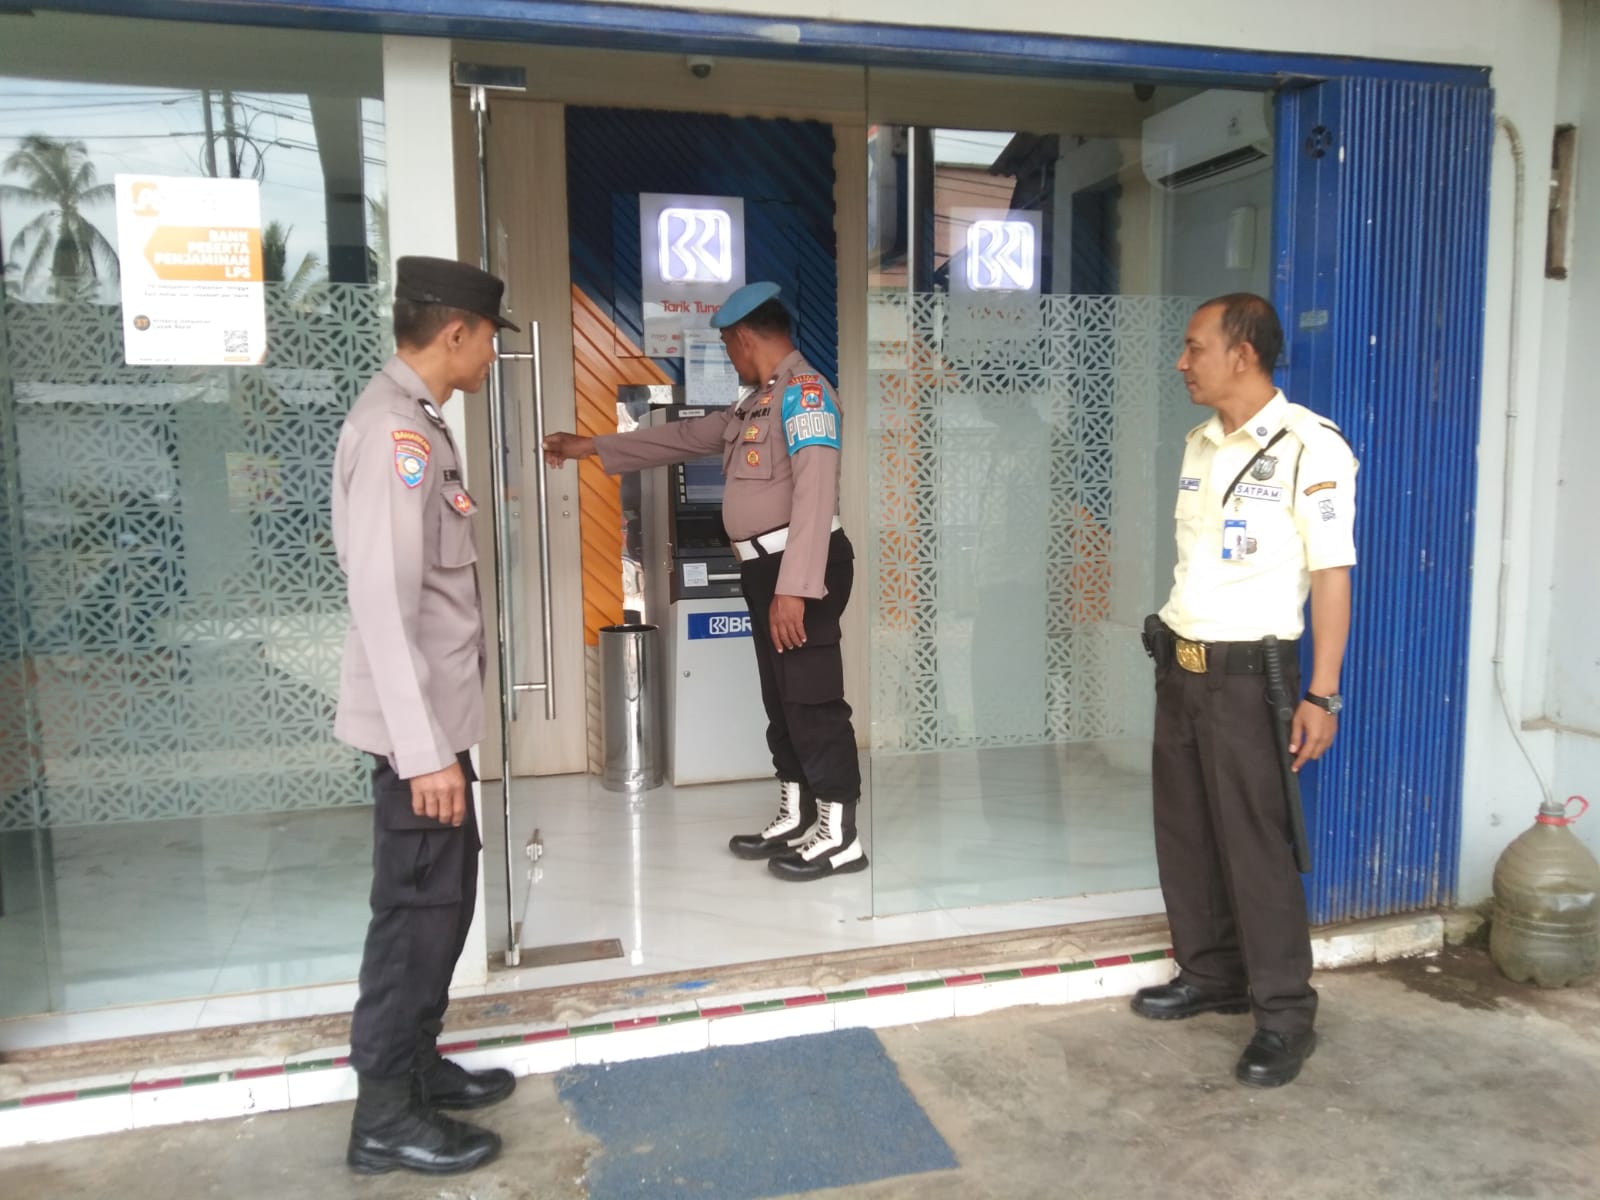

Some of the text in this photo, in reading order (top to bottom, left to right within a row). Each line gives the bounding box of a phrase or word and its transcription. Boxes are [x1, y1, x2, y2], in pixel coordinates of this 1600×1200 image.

[208, 229, 249, 242] BANK
[187, 241, 250, 254] PESERTA
[153, 252, 250, 265] PENJAMINAN
[224, 265, 252, 278] LPS
[660, 300, 690, 313] Tarik
[785, 411, 837, 447] PROV
[1236, 484, 1280, 498] SATPAM
[729, 616, 752, 632] BR
